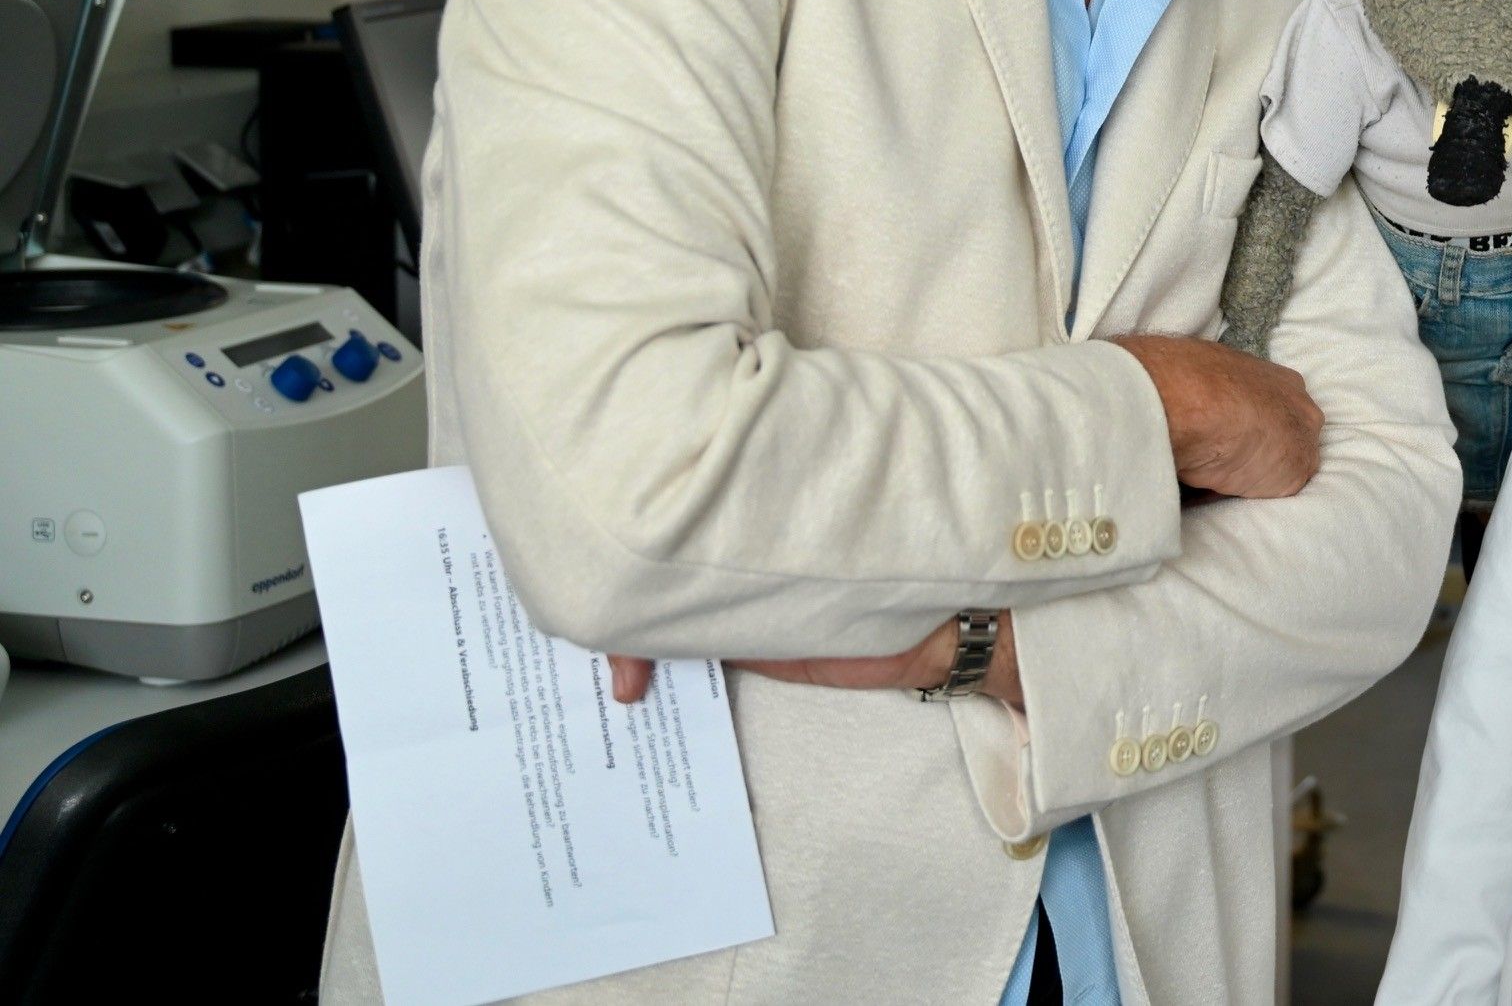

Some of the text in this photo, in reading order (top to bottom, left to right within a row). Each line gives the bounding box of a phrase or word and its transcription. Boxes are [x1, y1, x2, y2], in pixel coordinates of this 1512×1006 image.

[437, 527, 449, 554] 16:35
[251, 562, 305, 593] eppendorf
[442, 556, 453, 575] Uhr
[448, 585, 461, 635] Abschluss
[456, 637, 465, 647] &
[458, 649, 478, 732] Verabschiedung
[590, 657, 615, 769] Kinderkrebsforschung
